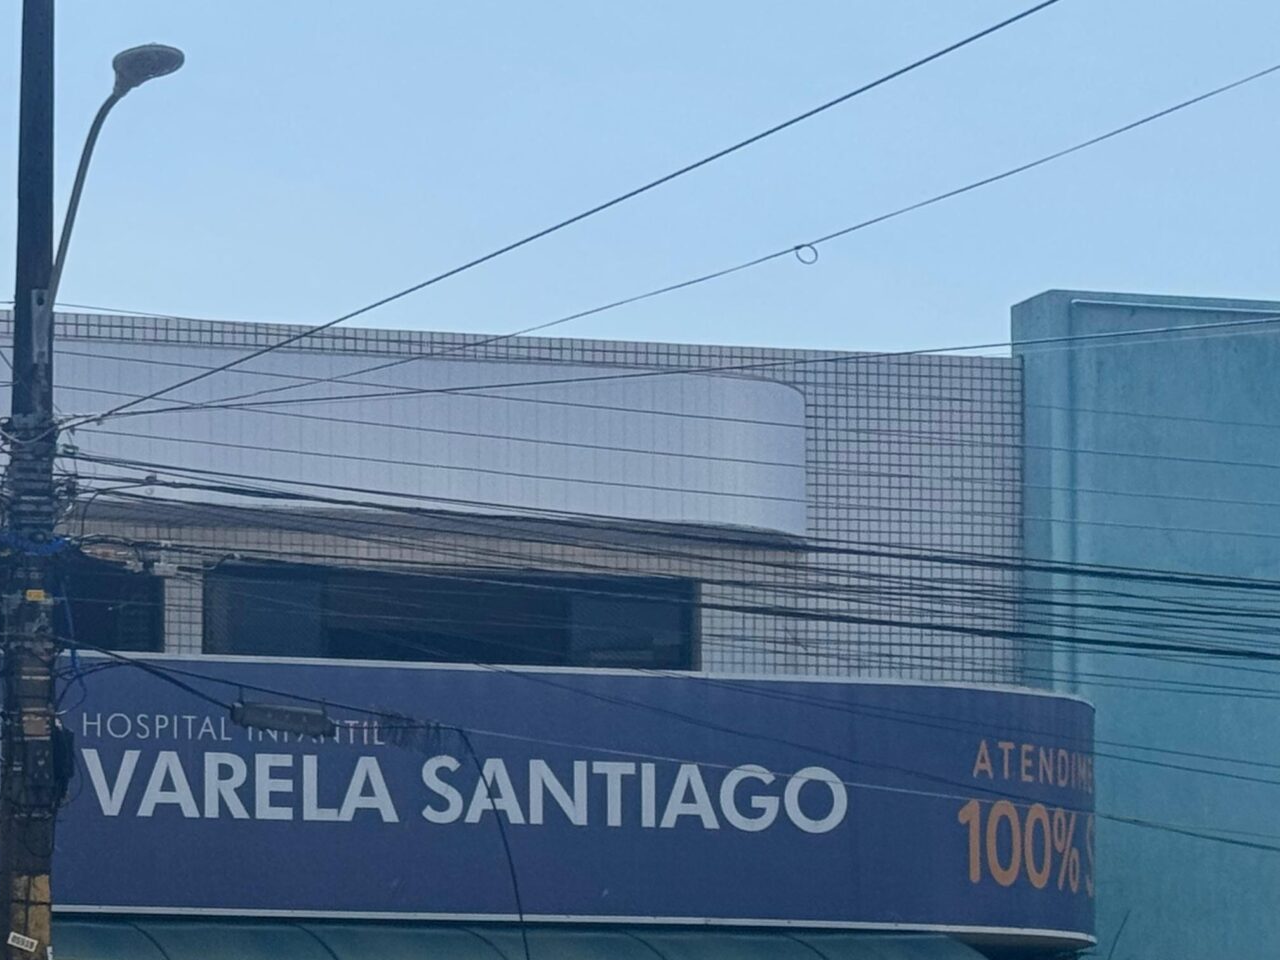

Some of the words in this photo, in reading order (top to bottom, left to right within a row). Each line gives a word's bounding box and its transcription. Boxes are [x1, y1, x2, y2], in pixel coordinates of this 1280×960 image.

[81, 711, 232, 743] HOSPITAL
[81, 747, 400, 824] VARELA
[420, 753, 848, 835] SANTIAGO
[957, 799, 1080, 894] 100%
